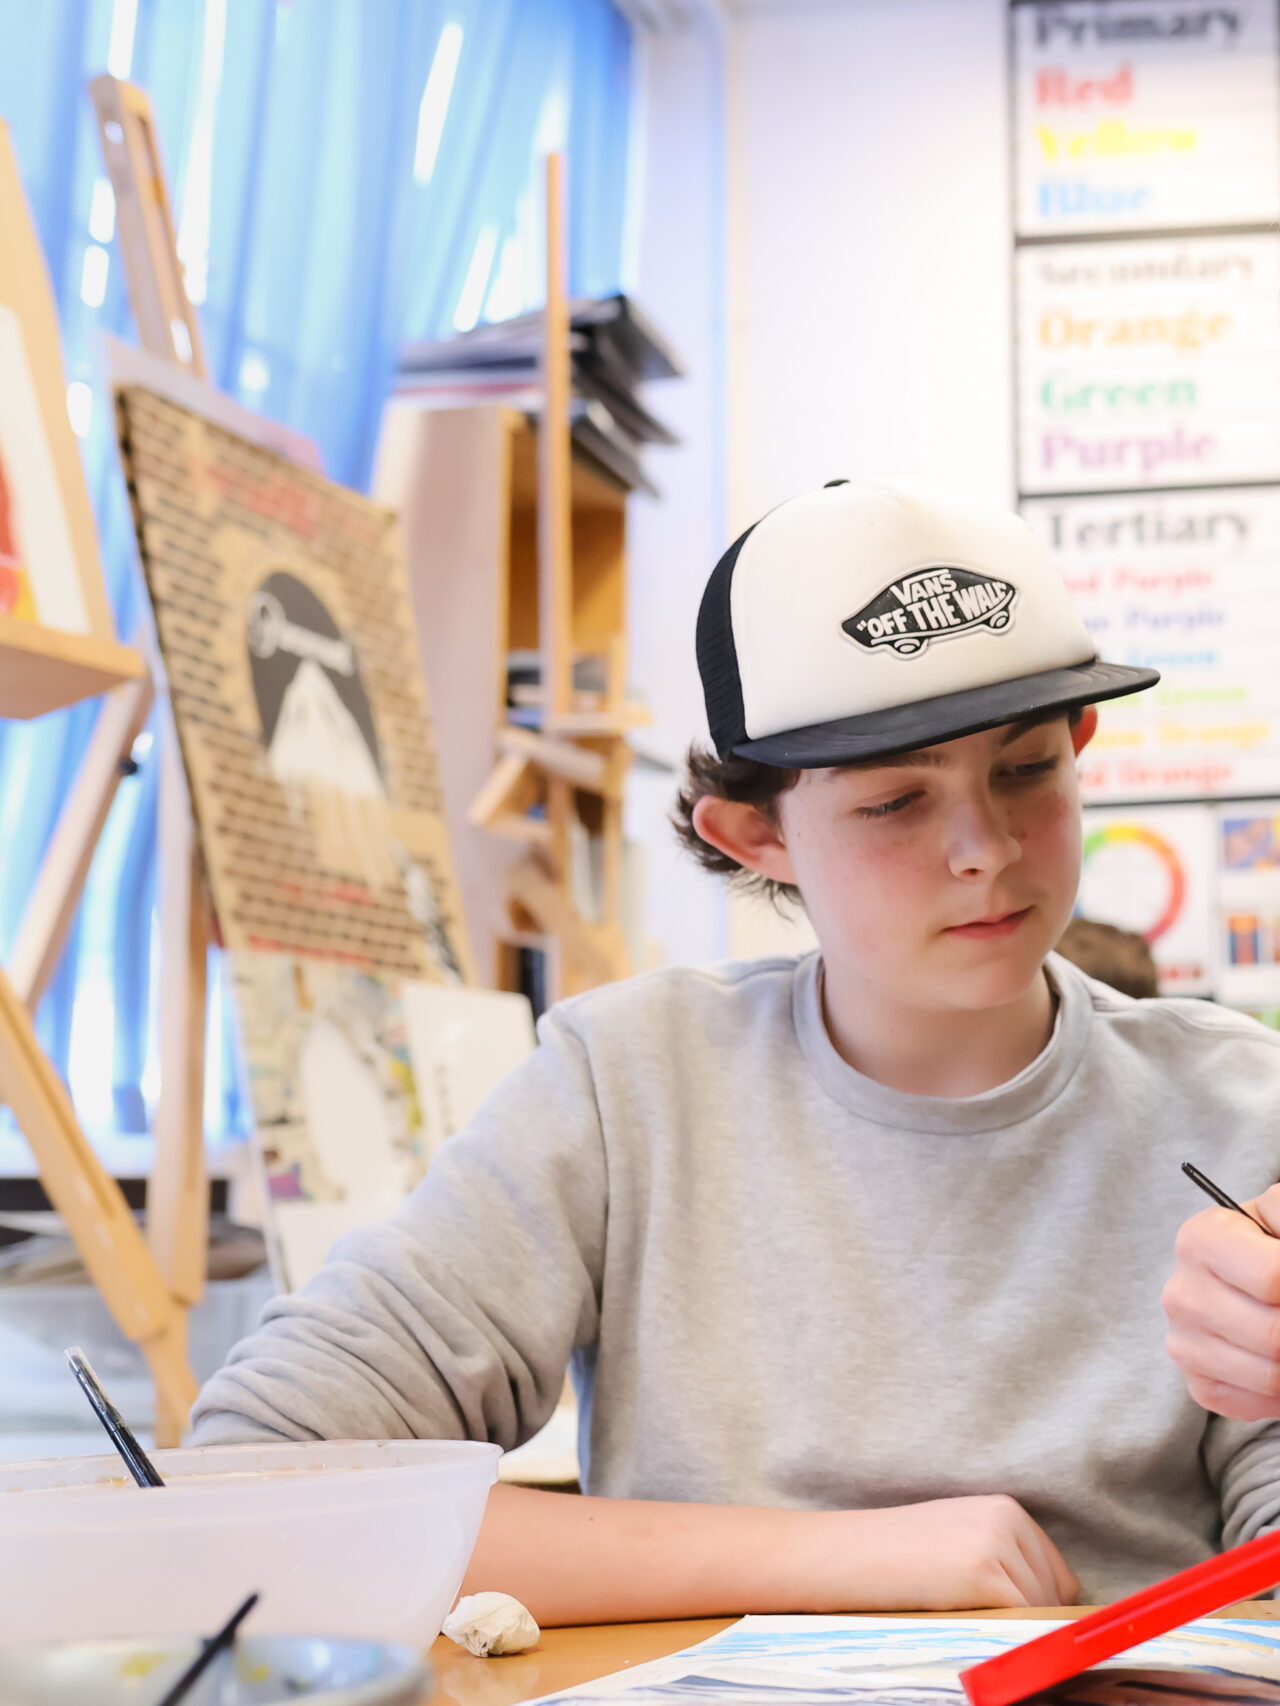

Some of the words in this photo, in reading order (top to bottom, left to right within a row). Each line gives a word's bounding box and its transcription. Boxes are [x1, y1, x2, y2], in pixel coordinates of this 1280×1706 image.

[1035, 6, 1243, 51] Primary
[1036, 62, 1134, 108] Red
[1036, 120, 1197, 161] Yellow
[1038, 181, 1151, 216] Blue
[1038, 308, 1233, 355] Orange
[1040, 376, 1198, 411] Green
[1041, 424, 1217, 479] Purple
[1046, 509, 1252, 555] Tertiary
[889, 569, 958, 606] VANS
[906, 593, 961, 631] THE
